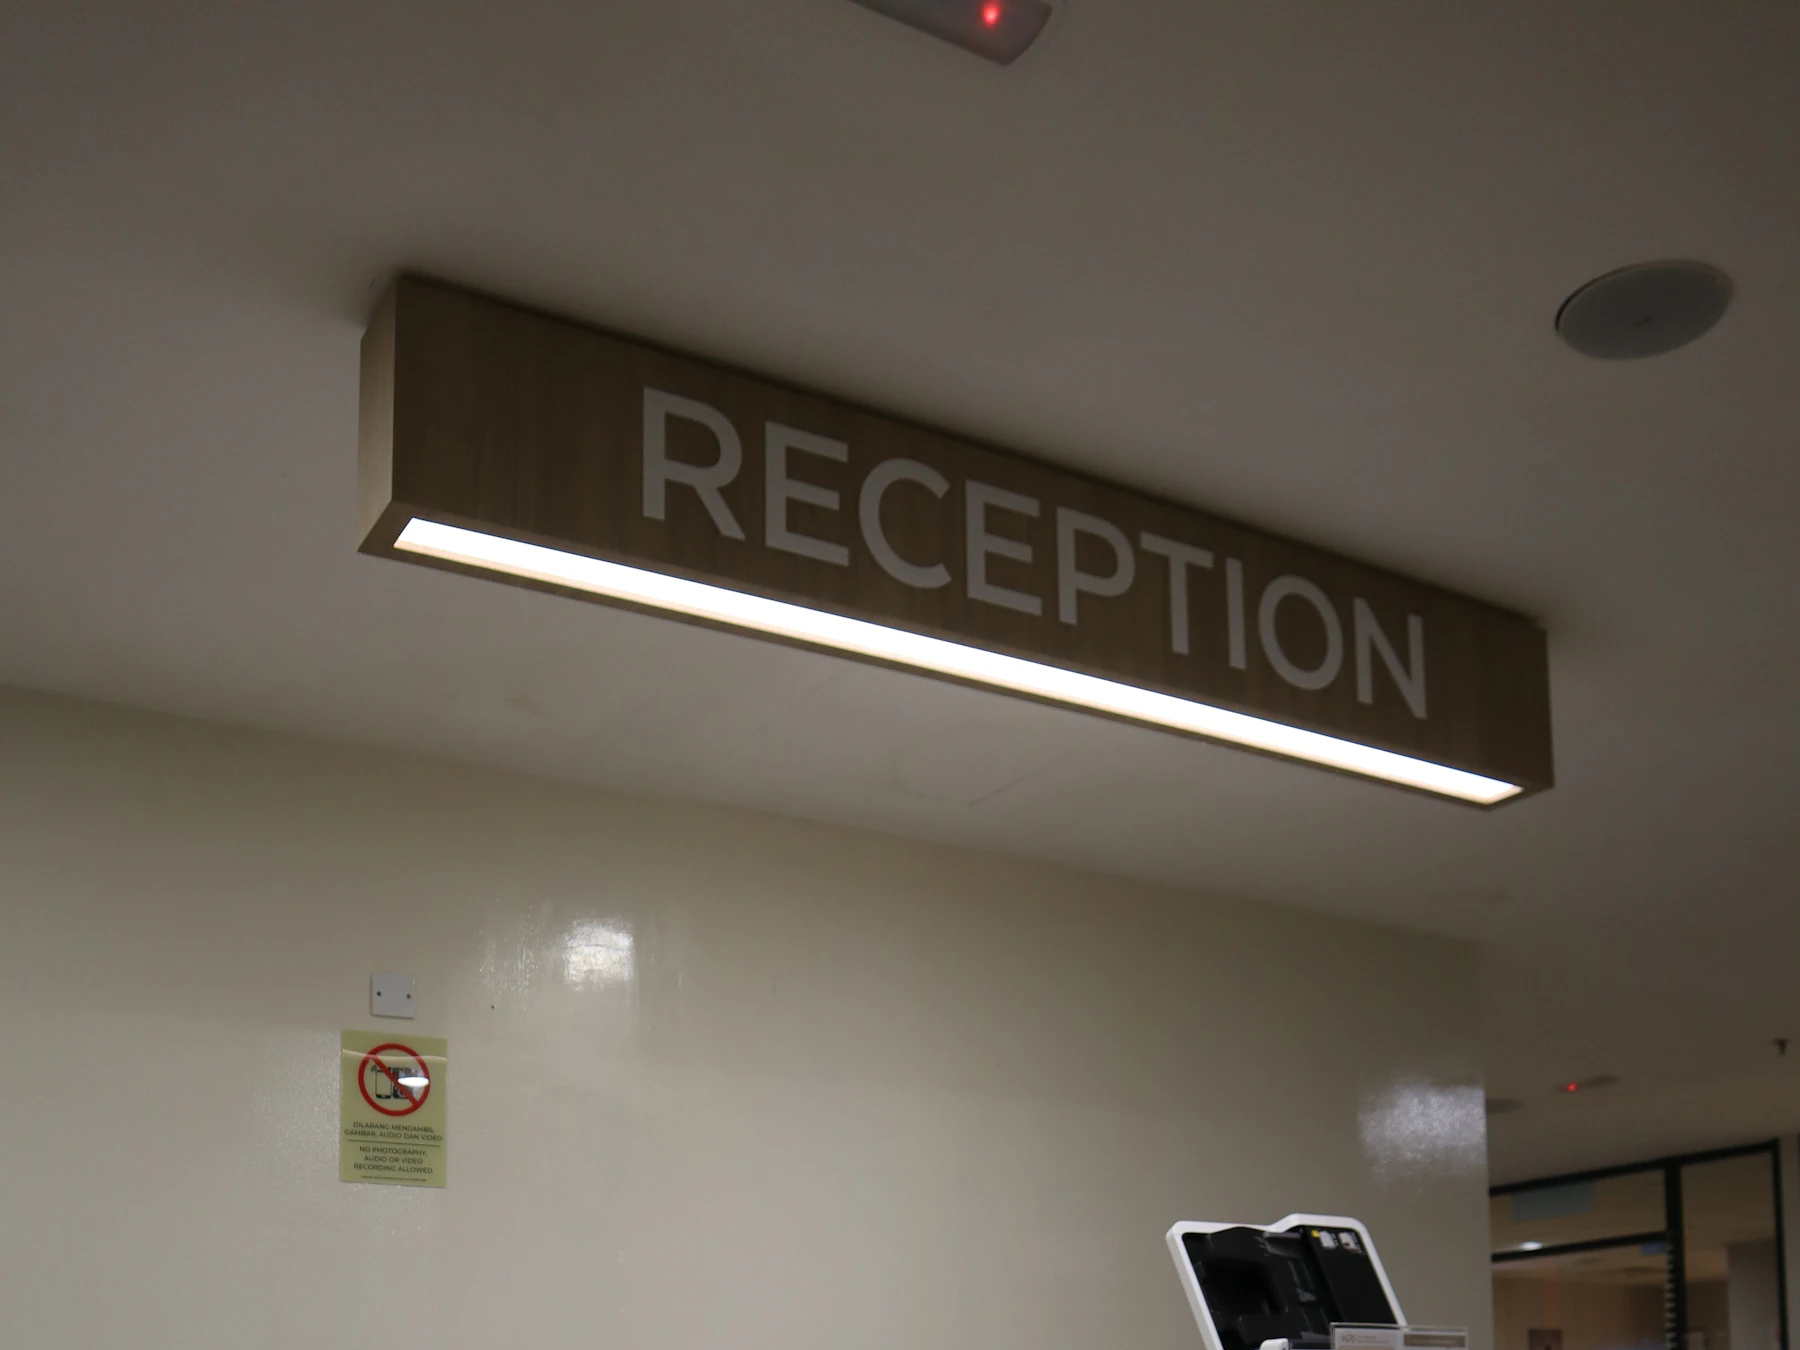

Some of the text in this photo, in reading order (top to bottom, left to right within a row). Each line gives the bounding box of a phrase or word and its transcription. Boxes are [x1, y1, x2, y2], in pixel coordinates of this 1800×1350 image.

[641, 386, 1428, 720] RECEPTION
[353, 1121, 434, 1133] DILARANG MENGAMBIL
[420, 1134, 443, 1142] VIDEO
[400, 1157, 423, 1165] VIDEO
[353, 1163, 433, 1174] RECORDING ALLOWED
